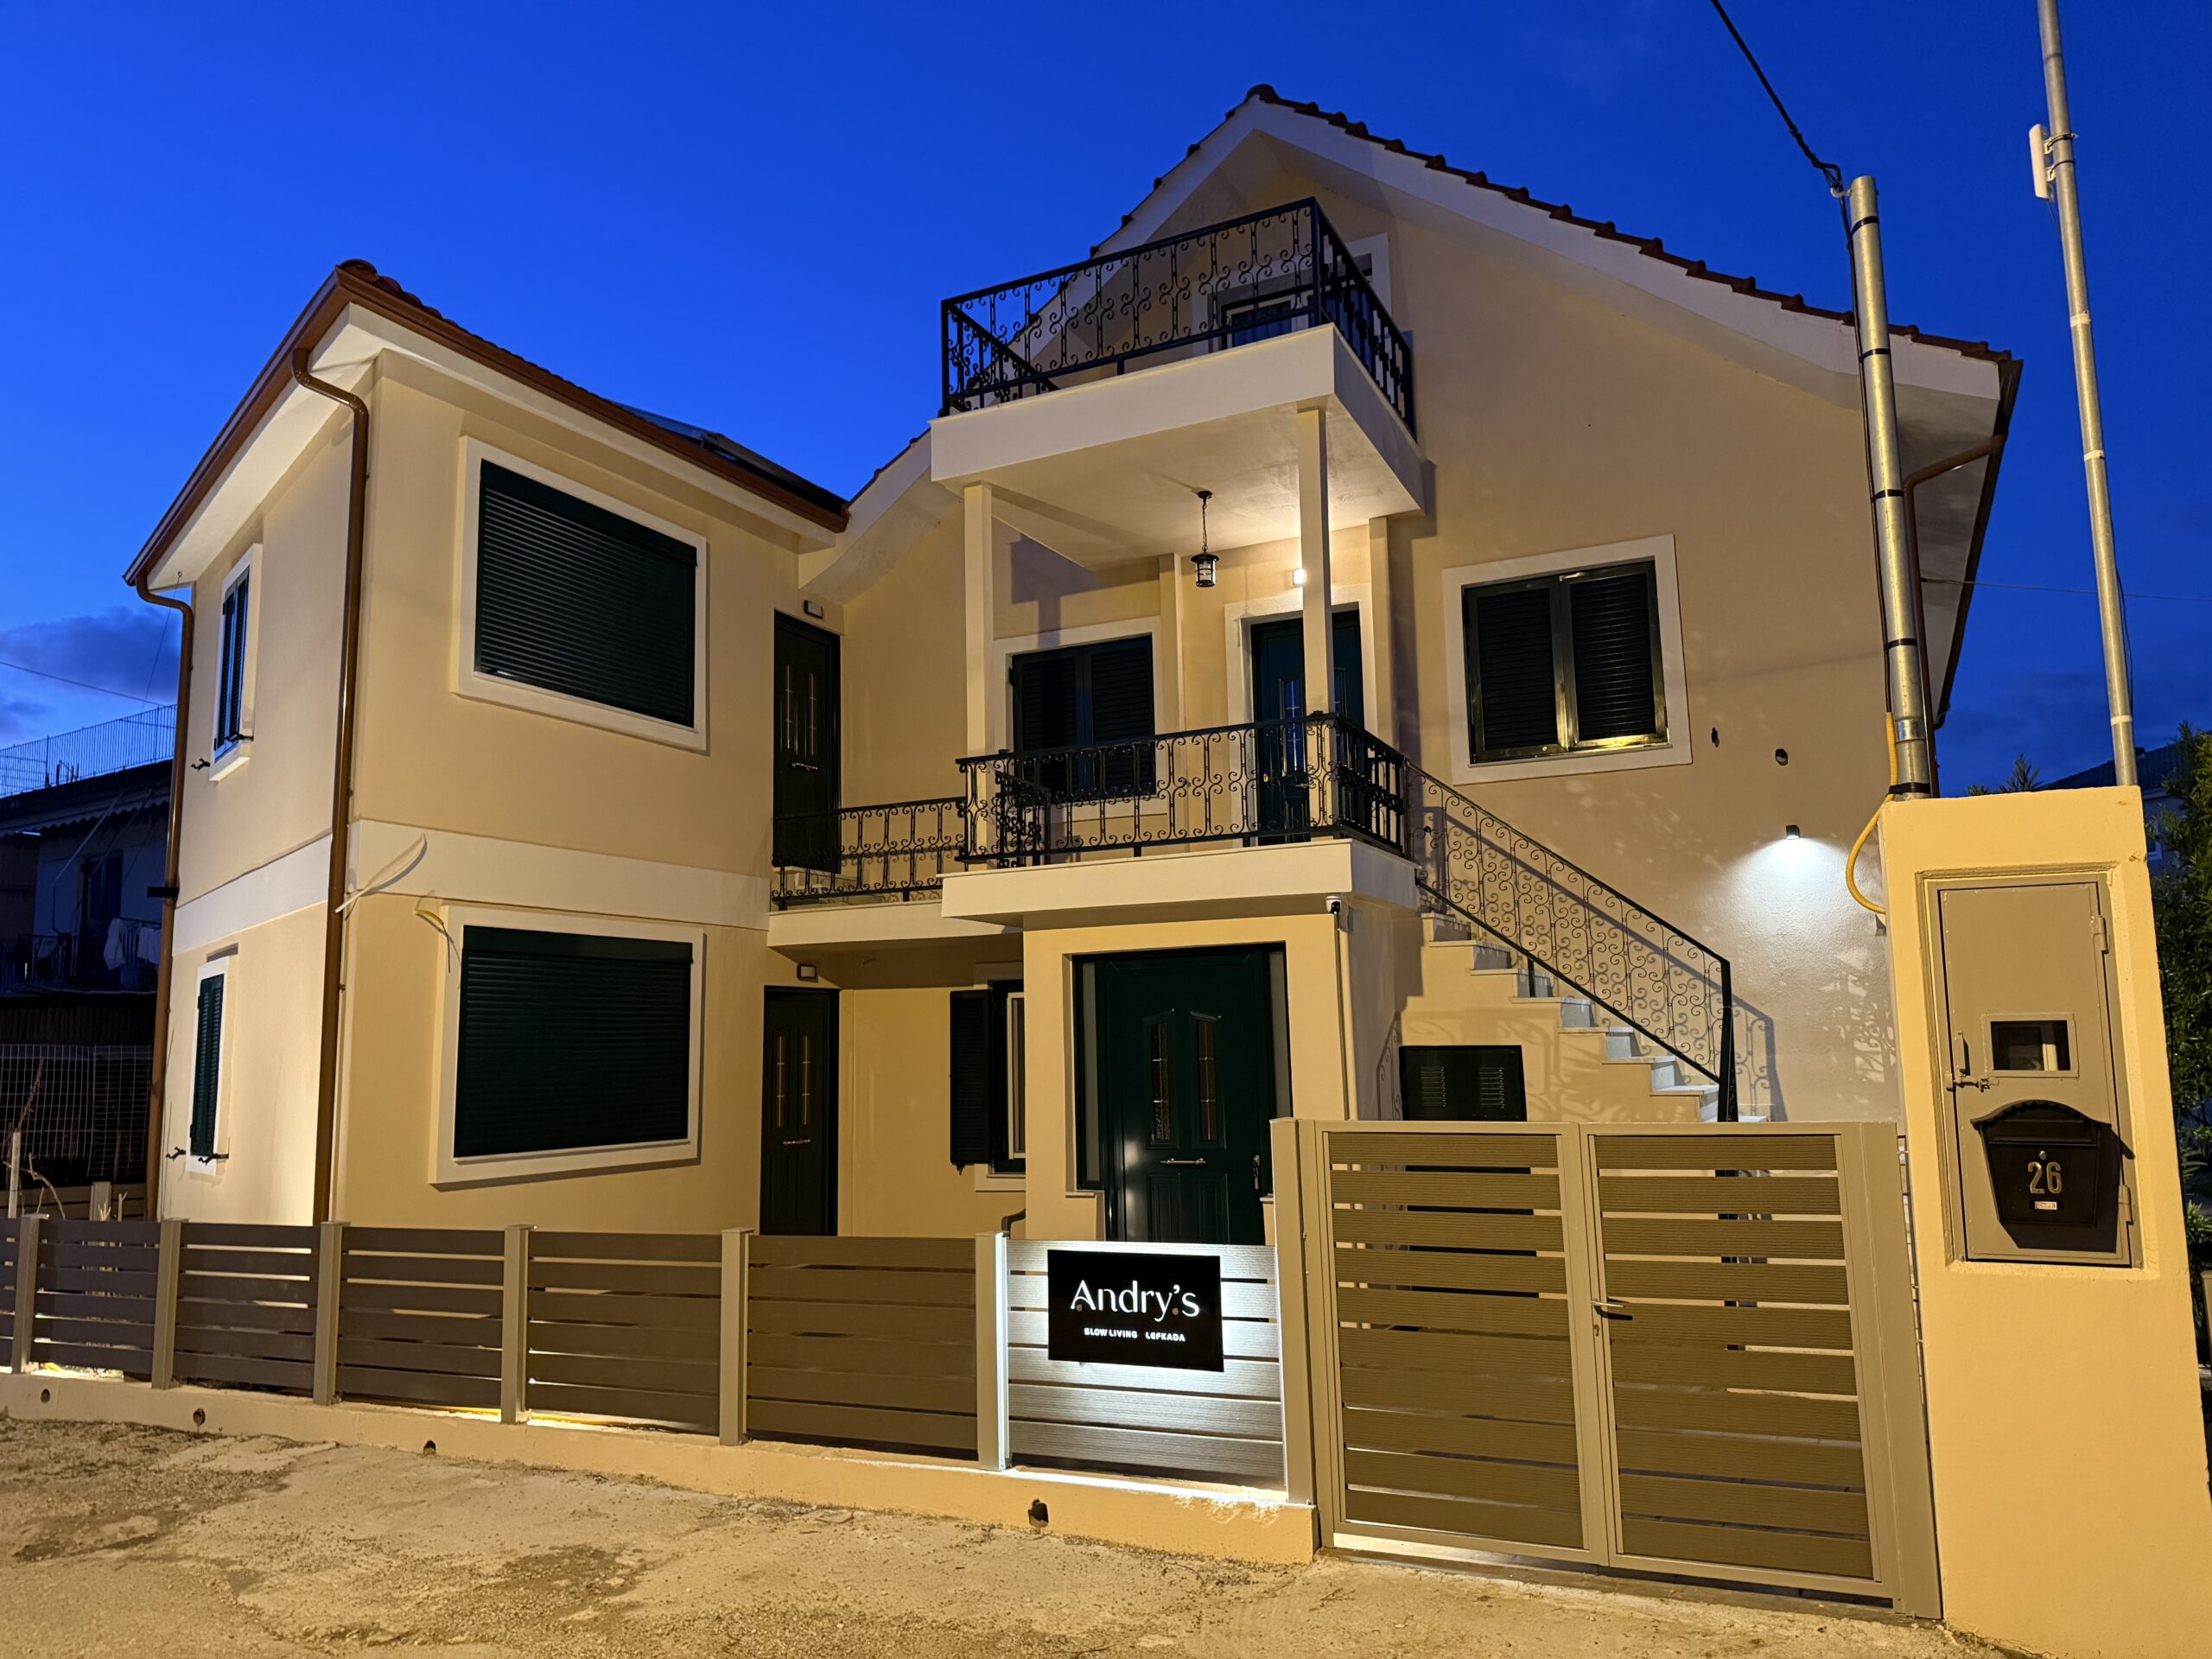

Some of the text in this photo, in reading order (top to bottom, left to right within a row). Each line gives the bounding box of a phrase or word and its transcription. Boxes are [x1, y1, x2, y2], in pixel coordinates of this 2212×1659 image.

[2027, 1161, 2063, 1194] 26
[1070, 1279, 1200, 1323] Andry's
[1084, 1327, 1186, 1342] SLOW LIVING LEFKADA
